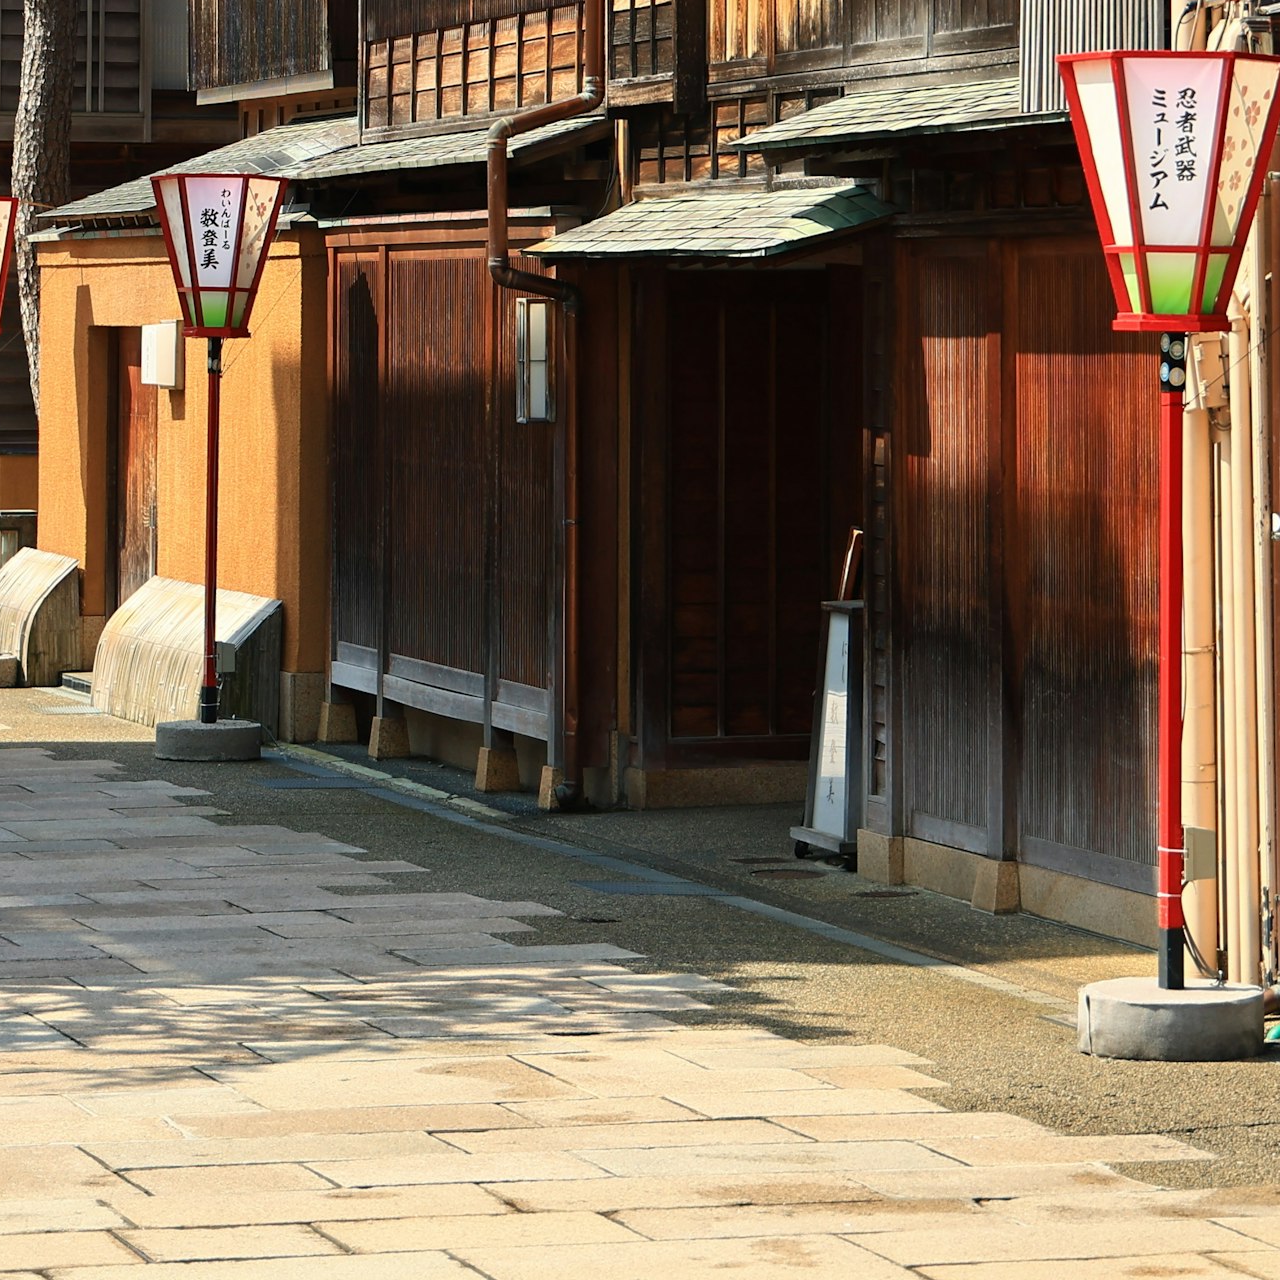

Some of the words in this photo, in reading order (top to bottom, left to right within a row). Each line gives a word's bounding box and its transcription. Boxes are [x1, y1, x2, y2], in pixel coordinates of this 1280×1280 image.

[1148, 88, 1169, 211] ミュージアム
[1174, 87, 1198, 182] 忍者武器
[199, 208, 220, 270] 数登美
[220, 188, 232, 250] わいんばーる
